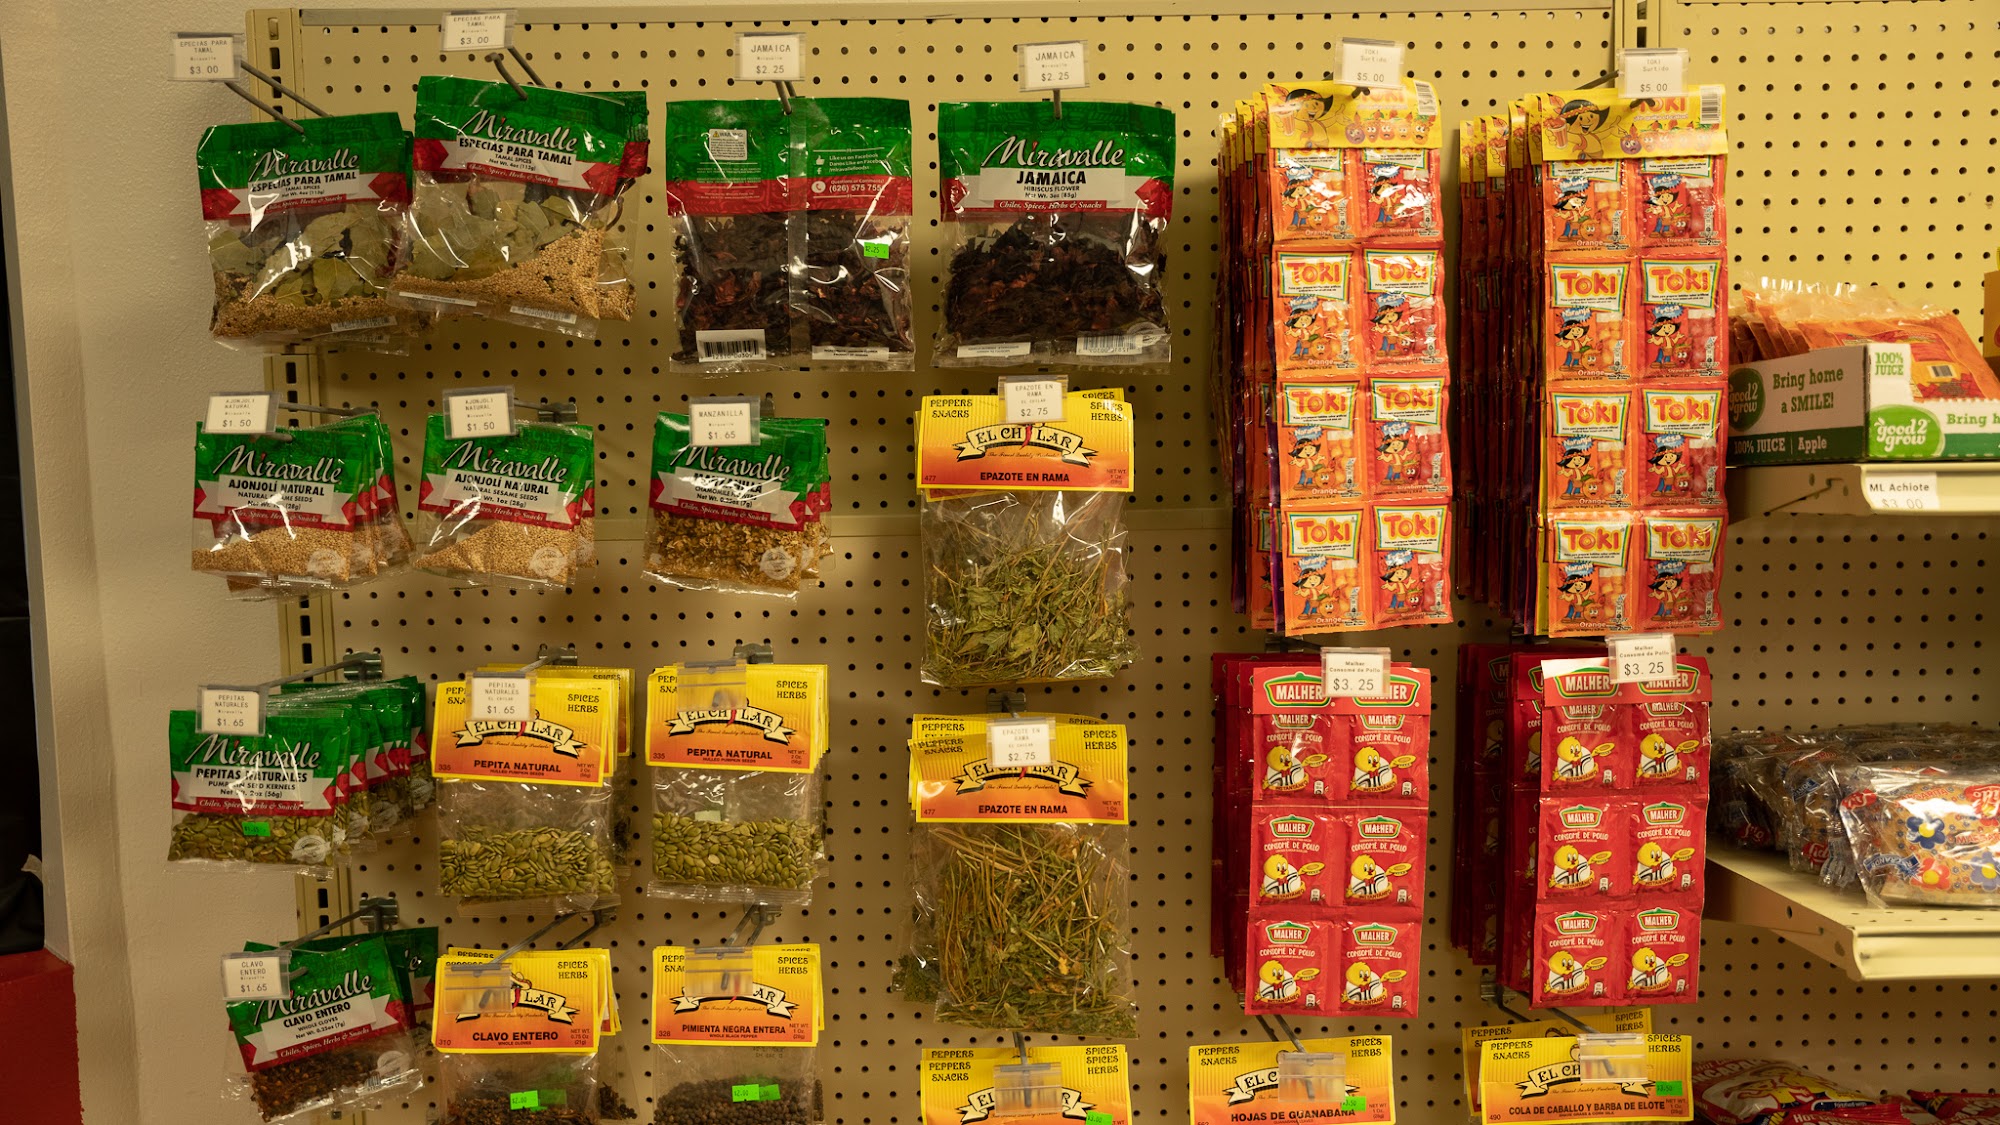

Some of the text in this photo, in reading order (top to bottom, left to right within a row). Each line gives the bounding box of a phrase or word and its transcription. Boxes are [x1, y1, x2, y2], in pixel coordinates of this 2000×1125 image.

[460, 36, 489, 45] $3.00
[751, 44, 791, 53] JAMAICA
[1035, 50, 1076, 61] JAMAICA
[756, 65, 785, 74] $2.25
[1041, 72, 1070, 82] $2.25
[1357, 72, 1385, 82] $5.00
[1640, 84, 1668, 92] $5.00
[457, 109, 578, 152] Miravalle
[459, 138, 572, 166] ESPECIAS PARA TAMAL
[981, 135, 1126, 169] Miravalle
[248, 148, 359, 182] Miravalle
[251, 171, 357, 193] ESPECIAS PARA TAMAL
[1016, 170, 1087, 186] JAMAICA
[1576, 240, 1603, 248] Orange
[1285, 260, 1341, 286] TOKI
[1558, 272, 1617, 296] TOKI
[1650, 267, 1709, 293] TOKI
[1307, 358, 1334, 367] Orange
[1874, 351, 1904, 364] 100%
[1578, 370, 1605, 378] Orange
[1874, 364, 1904, 376] JUICE
[1772, 367, 1844, 391] Bring home
[1377, 383, 1436, 411] TOKI
[930, 399, 973, 408] PEPPERS
[1781, 392, 1834, 414] a SMILE!
[698, 410, 744, 418] MANZANILLA
[932, 410, 970, 419] SNACKS
[1560, 400, 1619, 425] TOKI
[1652, 397, 1711, 422] TOKI
[1091, 412, 1123, 422] HERBS
[1946, 412, 1988, 428] Bring
[467, 422, 495, 432] $1.50
[1874, 417, 1928, 443] good2
[976, 429, 997, 445] EL
[1734, 436, 1828, 454] 100% JUICE Apple
[1884, 433, 1928, 454] grow
[213, 444, 344, 484] Miravalle
[441, 440, 568, 484] Miravalle
[670, 445, 790, 482] Miravalle
[980, 472, 1070, 482] EPAZOTE EN RAMA
[228, 478, 325, 496] AJONJOLÍ NATURAL
[1311, 488, 1338, 496] Orange
[1869, 482, 1930, 492] ML Achiote
[1295, 518, 1351, 545] TOKI
[1562, 527, 1620, 553] TOKI
[1624, 662, 1664, 676] $3.25
[776, 680, 808, 689] SPICES
[1333, 678, 1374, 692] $3.25
[1565, 675, 1610, 692] MALHER
[776, 691, 807, 700] HERBS
[1276, 684, 1324, 700] MALHER
[568, 694, 600, 703] SPICES
[487, 705, 516, 714] $1.65
[568, 704, 598, 714] HERBS
[217, 718, 244, 728] $1.65
[1368, 714, 1397, 726] MALHER
[922, 724, 965, 732] PEPPERS
[1084, 730, 1118, 739] SPICES
[1085, 742, 1118, 750] HERBS
[185, 734, 322, 769] Miravalle
[687, 748, 772, 760] PEPITA NATURAL
[1008, 752, 1036, 762] $2.75
[474, 760, 562, 773] PEPITA NATURAL
[196, 768, 240, 780] PEPITAS
[978, 805, 1068, 815] EPAZOTE EN RAMA
[1567, 813, 1594, 824] MALHER
[1277, 824, 1306, 834] MALHER
[1562, 920, 1590, 930] MALHER
[1274, 930, 1302, 940] MALHER
[1360, 931, 1390, 942] MALHER
[558, 960, 588, 970] SPICES
[778, 956, 808, 966] SPICES
[240, 968, 266, 976] ENTERO
[558, 971, 588, 980] HERBS
[778, 966, 808, 976] HERBS
[240, 984, 268, 993] $1.65
[254, 969, 374, 1027] Miravalle
[283, 1002, 351, 1028] CLAVO ENTERO
[682, 1024, 786, 1034] PIMIENTA NEGRA ENTERA
[472, 1032, 558, 1042] CLAVO ENTERO
[1647, 1034, 1682, 1043] SPICES
[1350, 1038, 1382, 1048] SPICES
[1490, 1041, 1533, 1051] PEPPERS
[1198, 1046, 1240, 1056] PEPPERS
[1351, 1048, 1382, 1058] HERBS
[1648, 1044, 1682, 1053] HERBS
[1086, 1056, 1120, 1064] SPICES
[1492, 1051, 1530, 1060] SNACKS
[1200, 1056, 1238, 1066] SNACKS
[930, 1062, 972, 1071] PEPPERS
[1088, 1066, 1119, 1076] HERBS
[932, 1073, 970, 1082] SNACKS
[1537, 1068, 1559, 1083] EL
[1244, 1075, 1264, 1089] EL
[1508, 1100, 1665, 1116] COLA DE CABALLO Y BARBA DE ELOTE
[1231, 1112, 1267, 1123] HOJAS
[1270, 1112, 1285, 1122] DE
